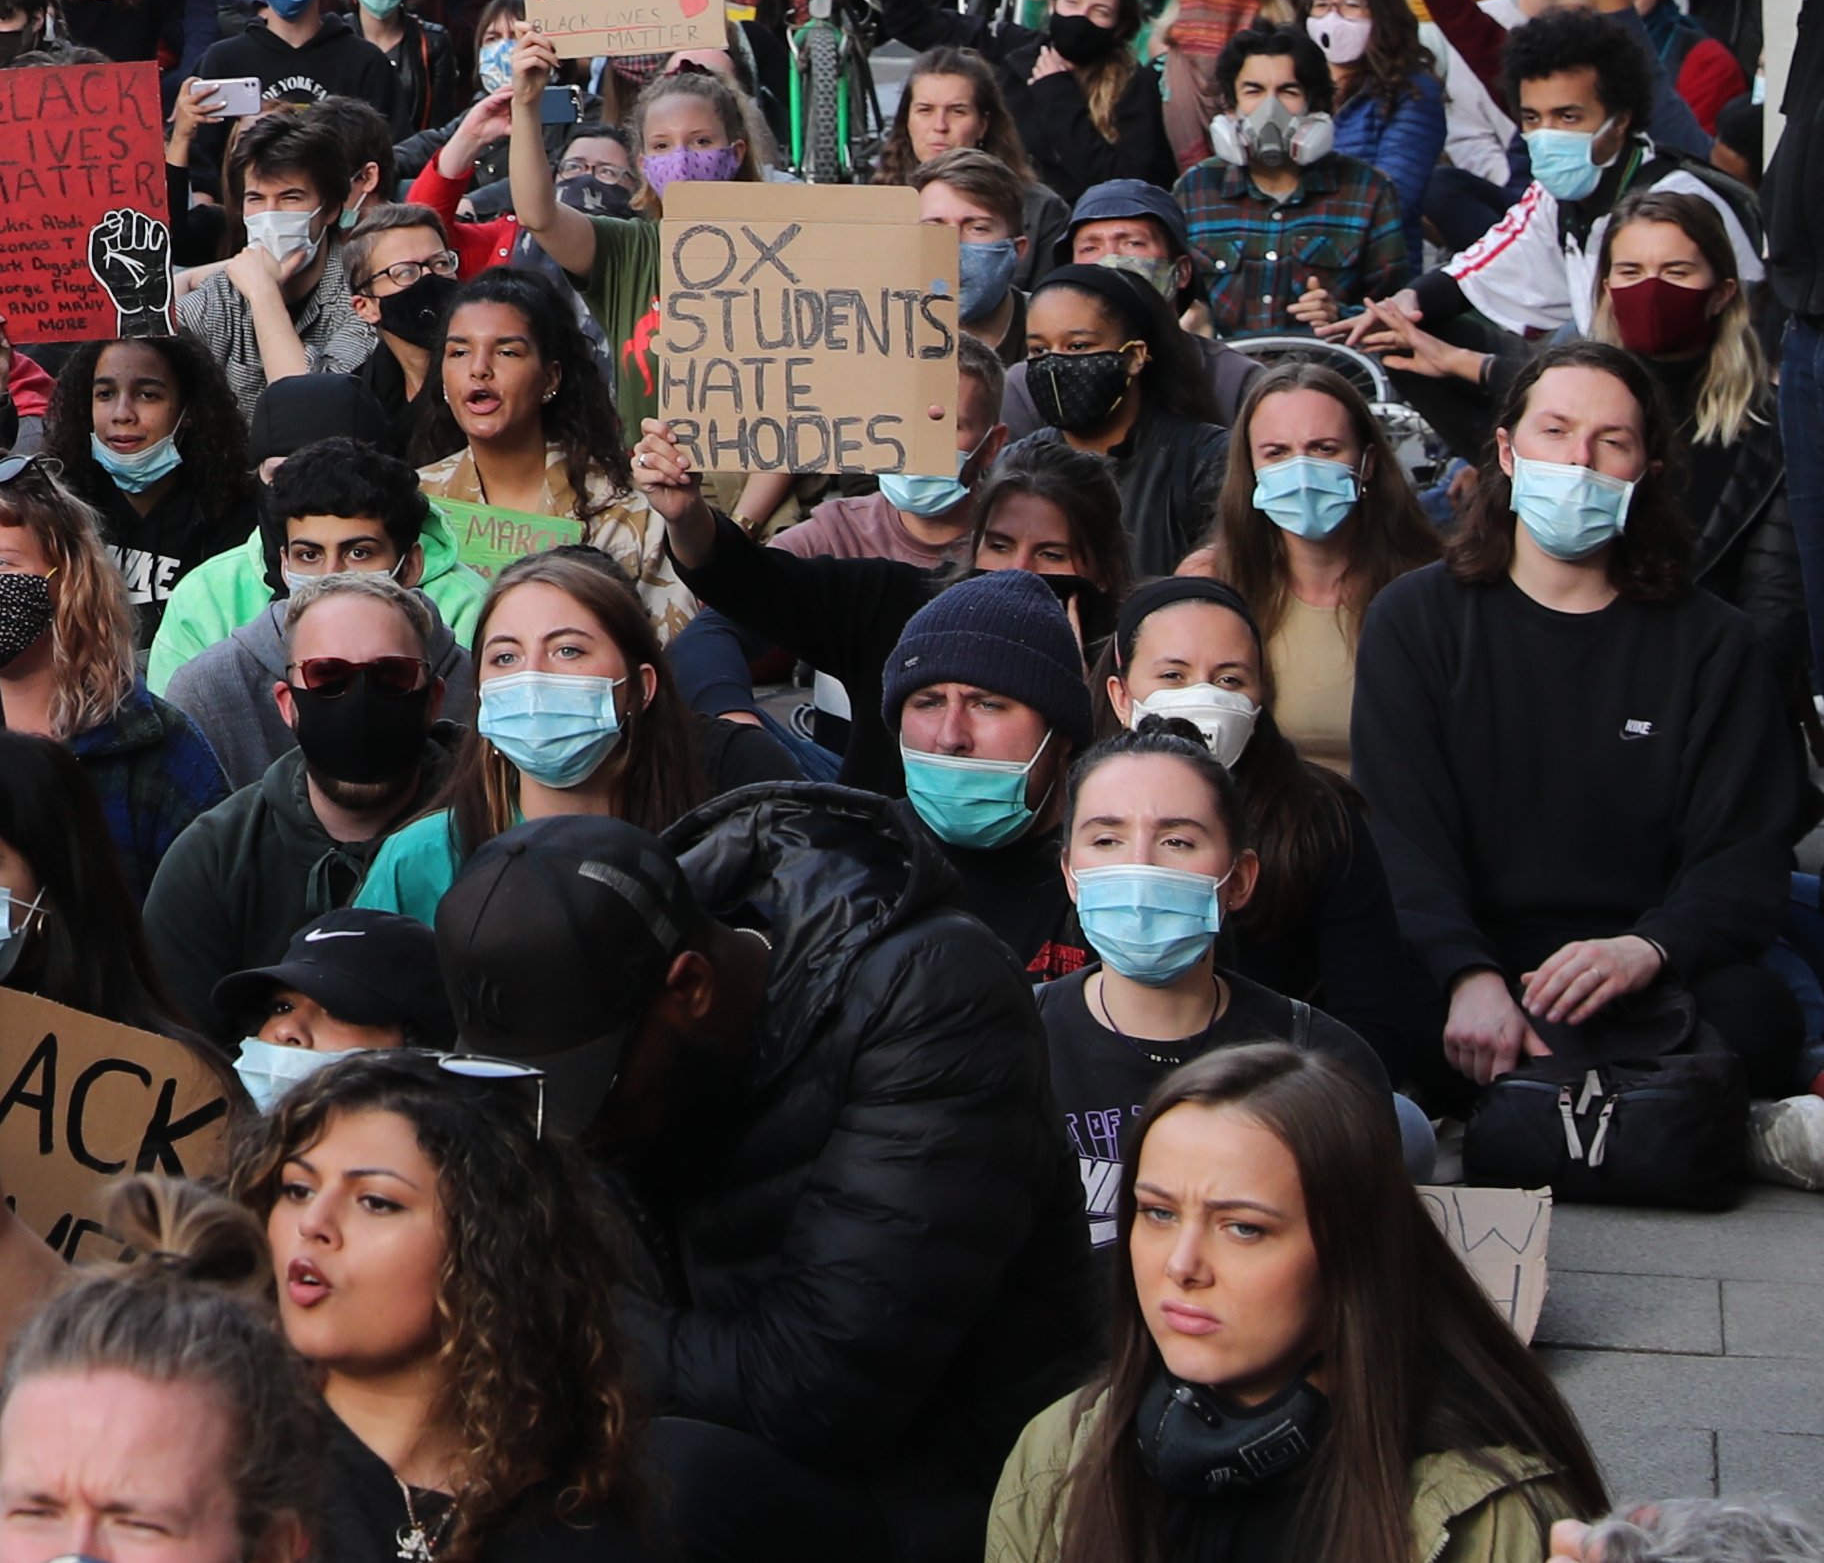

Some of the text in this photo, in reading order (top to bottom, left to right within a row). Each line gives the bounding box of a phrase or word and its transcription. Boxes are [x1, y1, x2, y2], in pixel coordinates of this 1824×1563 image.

[532, 8, 661, 34] BLACK LIVES
[607, 25, 701, 49] MATTER
[42, 214, 85, 231] Abdi
[32, 256, 88, 277] Duggan
[672, 223, 801, 290] OX
[52, 279, 98, 300] Floyd
[8, 299, 104, 316] AND MANY
[39, 317, 87, 332] MORE
[665, 287, 954, 359] STUDENTS
[662, 357, 821, 413] HATE
[666, 414, 906, 474] RHODES
[466, 515, 570, 555] MARCH
[1624, 718, 1652, 736] NIKE
